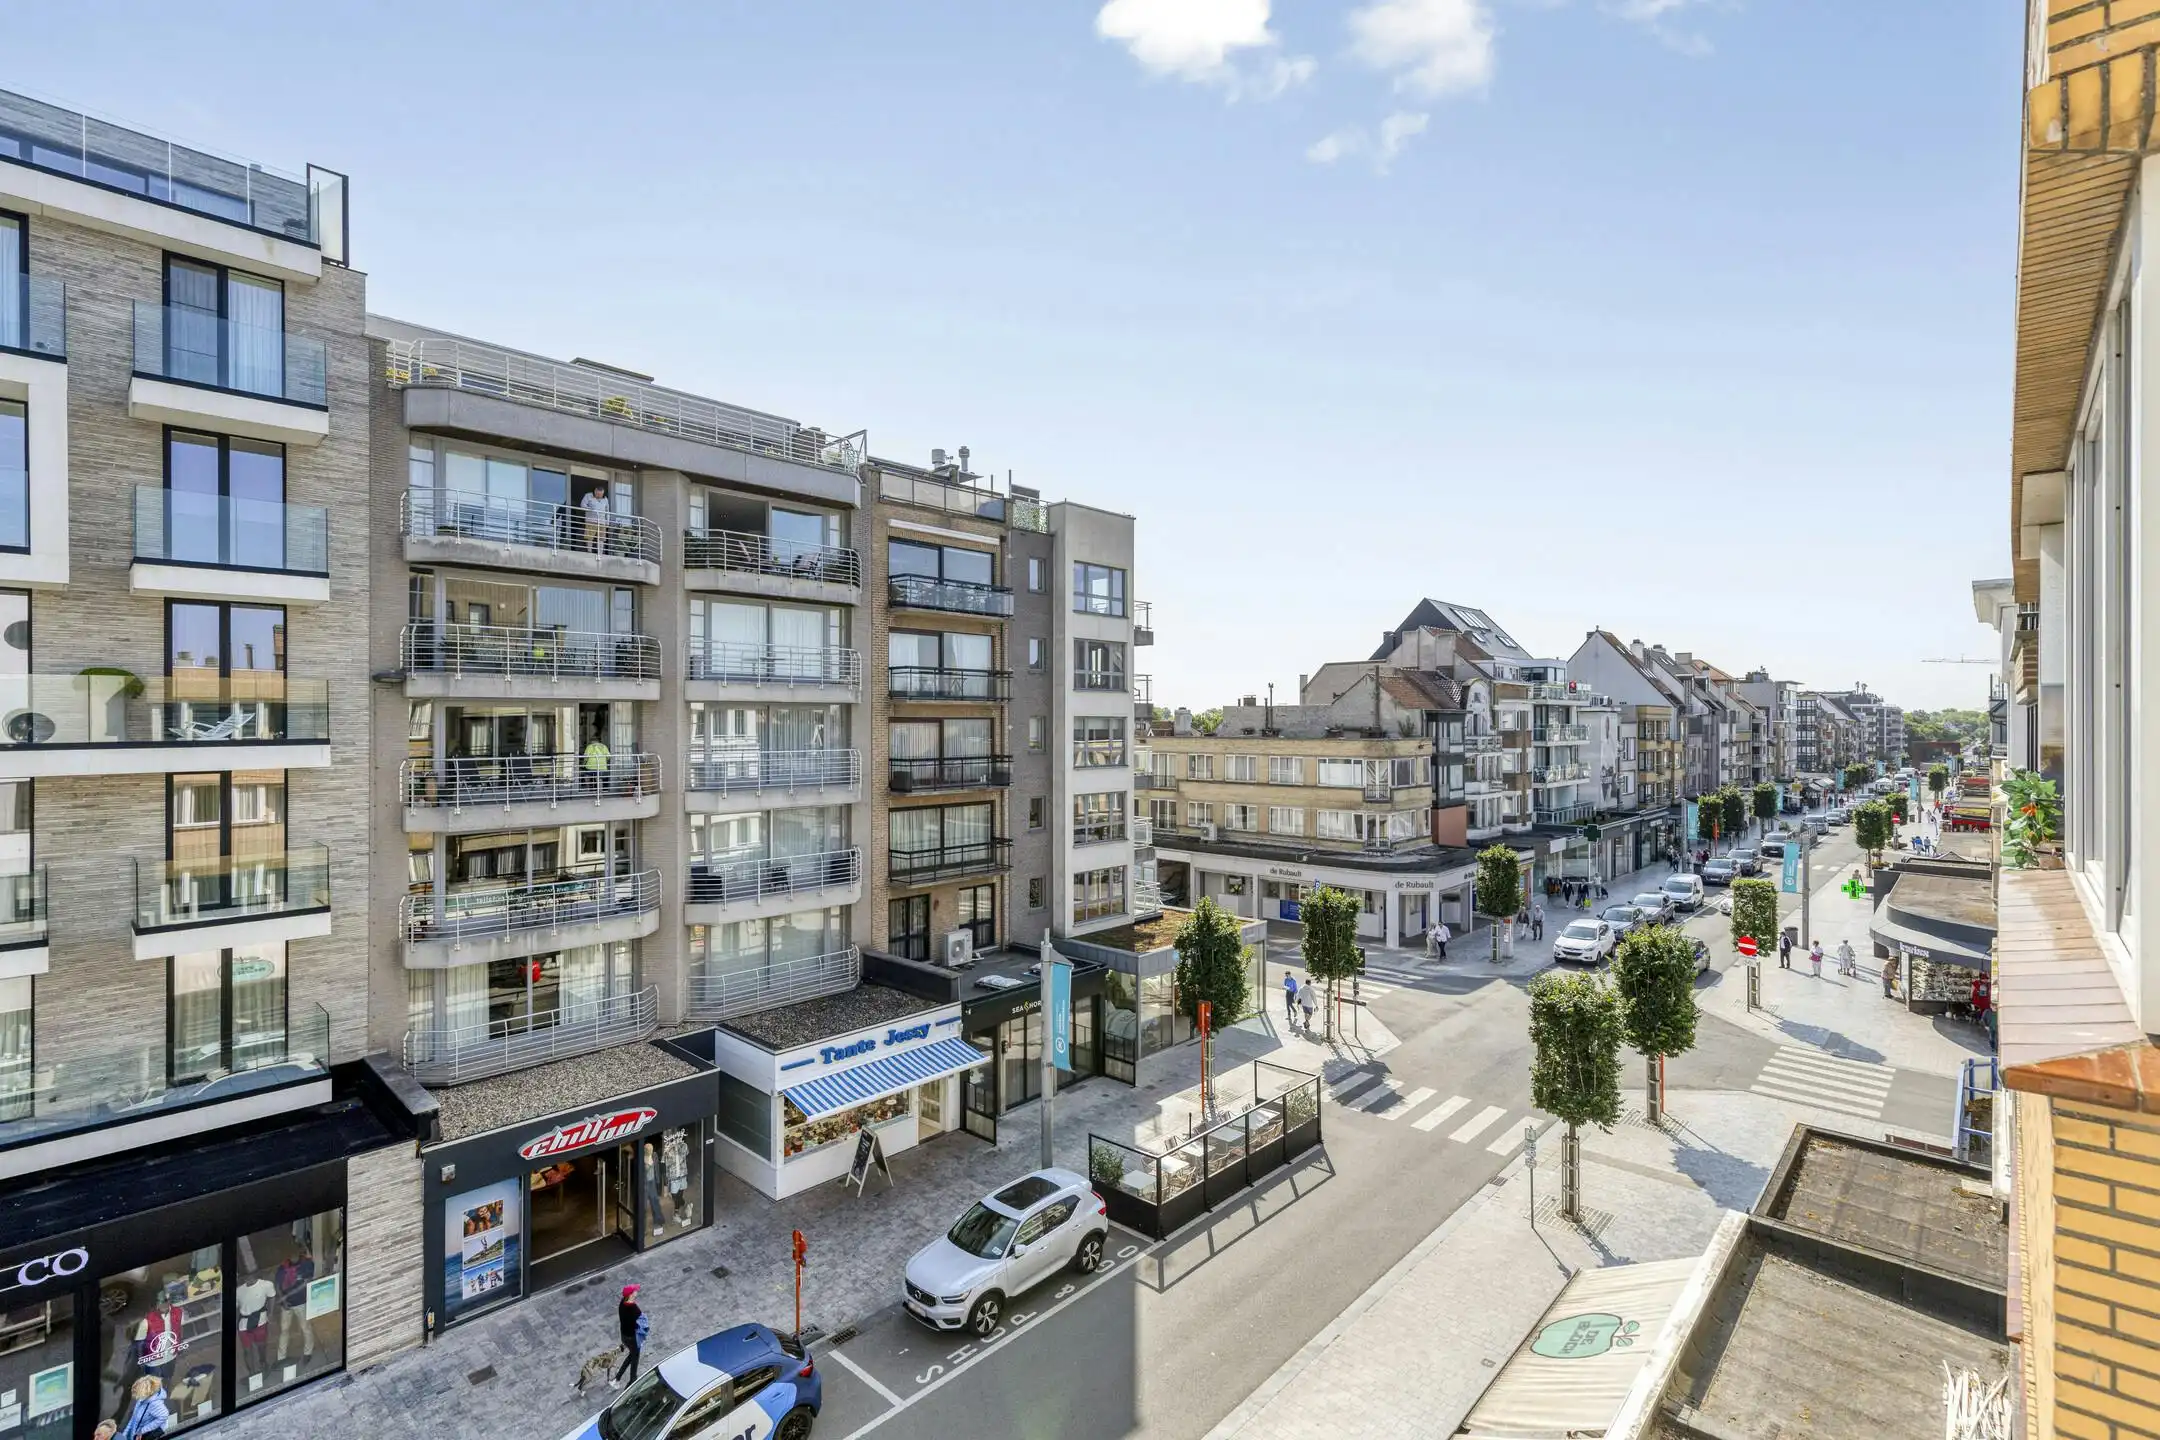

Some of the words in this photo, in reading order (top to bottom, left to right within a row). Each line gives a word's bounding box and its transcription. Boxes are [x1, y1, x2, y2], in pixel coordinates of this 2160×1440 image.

[1394, 881, 1404, 889] de
[1406, 881, 1434, 889] Rubault
[1012, 1005, 1024, 1014] SEA
[820, 1036, 877, 1065] Tante
[17, 1248, 89, 1286] CO
[915, 1310, 1038, 1384] SHOP
[1055, 1283, 1075, 1299] &
[1094, 1245, 1139, 1273] GO
